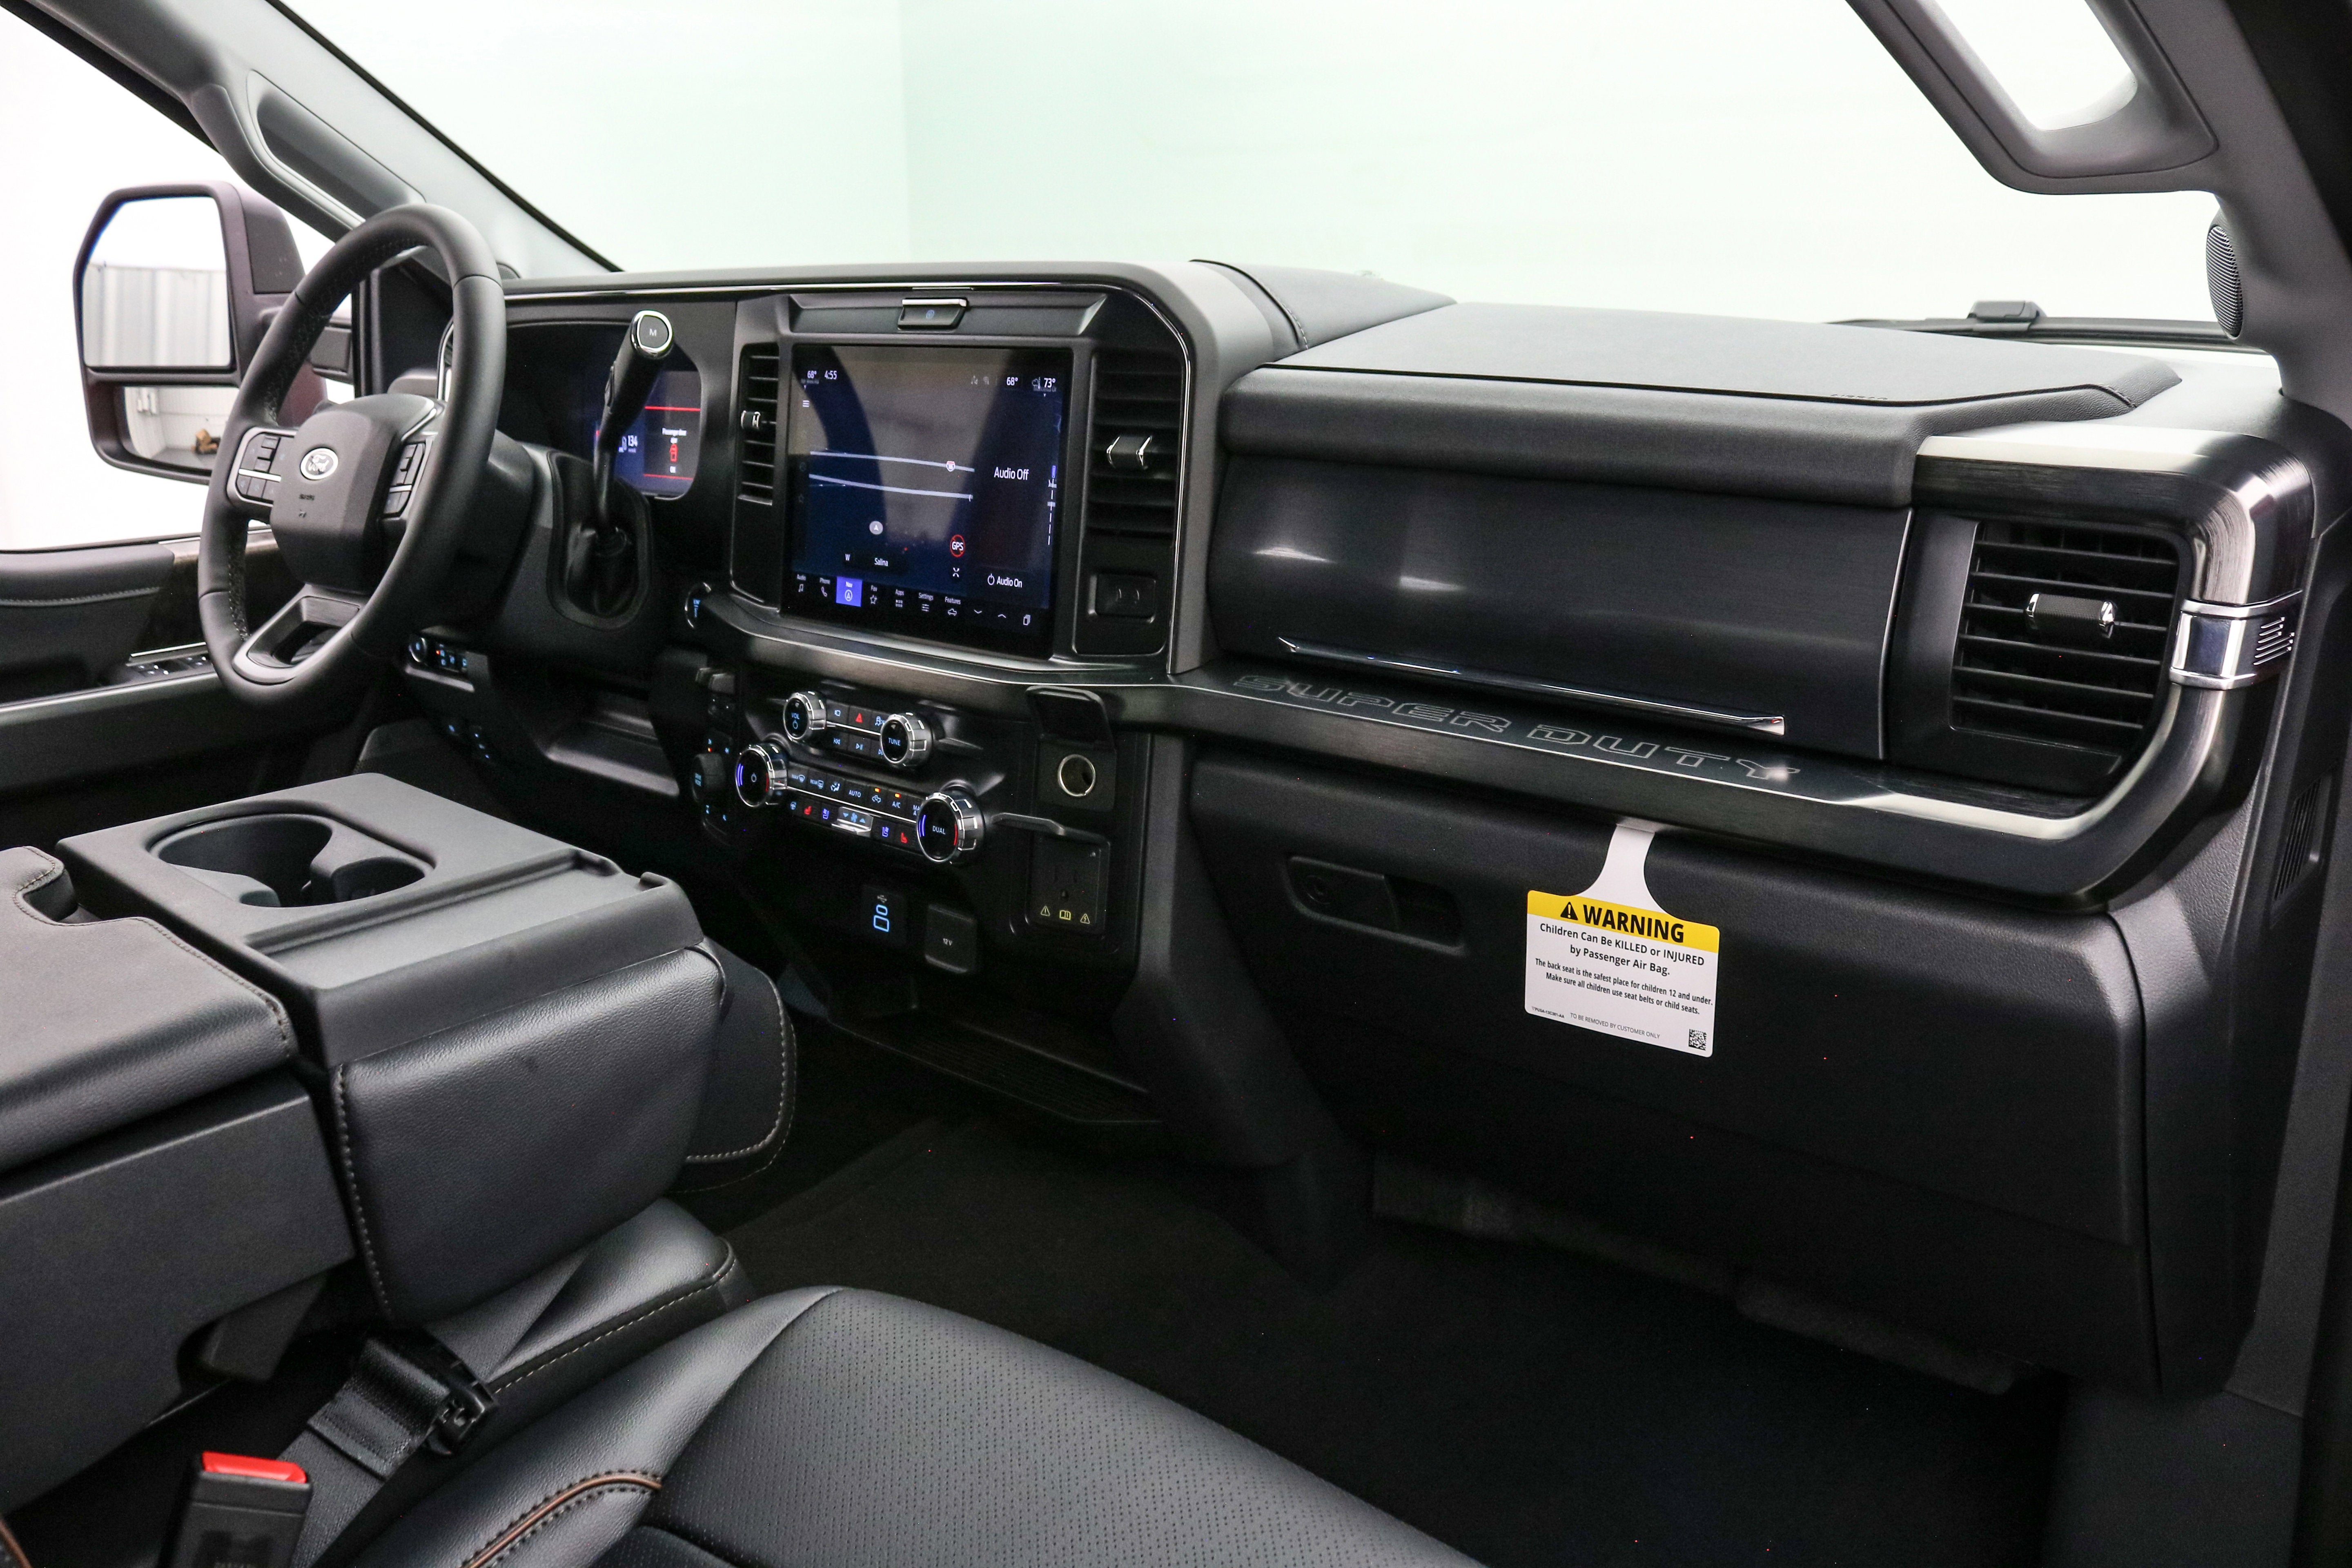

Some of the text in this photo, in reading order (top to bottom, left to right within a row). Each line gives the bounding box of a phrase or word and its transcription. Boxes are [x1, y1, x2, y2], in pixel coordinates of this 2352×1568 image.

[824, 370, 837, 380] 4:55
[1006, 376, 1018, 385] 68°
[1044, 378, 1056, 388] 73°
[628, 435, 638, 447] 134
[993, 466, 1029, 481] Audio Off
[951, 541, 964, 551] GPS
[874, 557, 889, 566] Salina
[996, 576, 1023, 588] Audio On
[918, 592, 934, 601] Settings
[944, 596, 961, 605] Features
[1233, 675, 1801, 779] SUPER DUTY
[888, 737, 901, 746] TUNE
[849, 789, 861, 798] AUTO
[932, 825, 946, 835] DUAL
[1583, 905, 1683, 942] WARNING
[1540, 923, 1578, 938] Children
[1581, 932, 1597, 943] Can
[1601, 936, 1612, 946] Be
[1615, 939, 1647, 953] KILLED
[1664, 949, 1704, 965] INJURED
[1570, 944, 1669, 976] by Passenger Air Bag.
[1535, 958, 1546, 967] The
[1547, 960, 1561, 970] back
[1562, 966, 1574, 974] seat
[1582, 969, 1592, 978] the
[1594, 973, 1611, 982] safest
[1613, 977, 1629, 987] place
[1631, 980, 1639, 989] for
[1642, 983, 1666, 995] children
[1669, 989, 1676, 997] 12
[1692, 996, 1713, 1005] under.
[1546, 972, 1562, 982] Make
[1586, 982, 1610, 994] children
[1624, 992, 1637, 1000] seat
[1639, 994, 1654, 1004] belts
[1664, 1000, 1679, 1009] child
[1682, 1005, 1699, 1014] seats.
[1585, 1016, 1608, 1027] REMOVED
[1617, 1025, 1645, 1035] CUSTOMER
